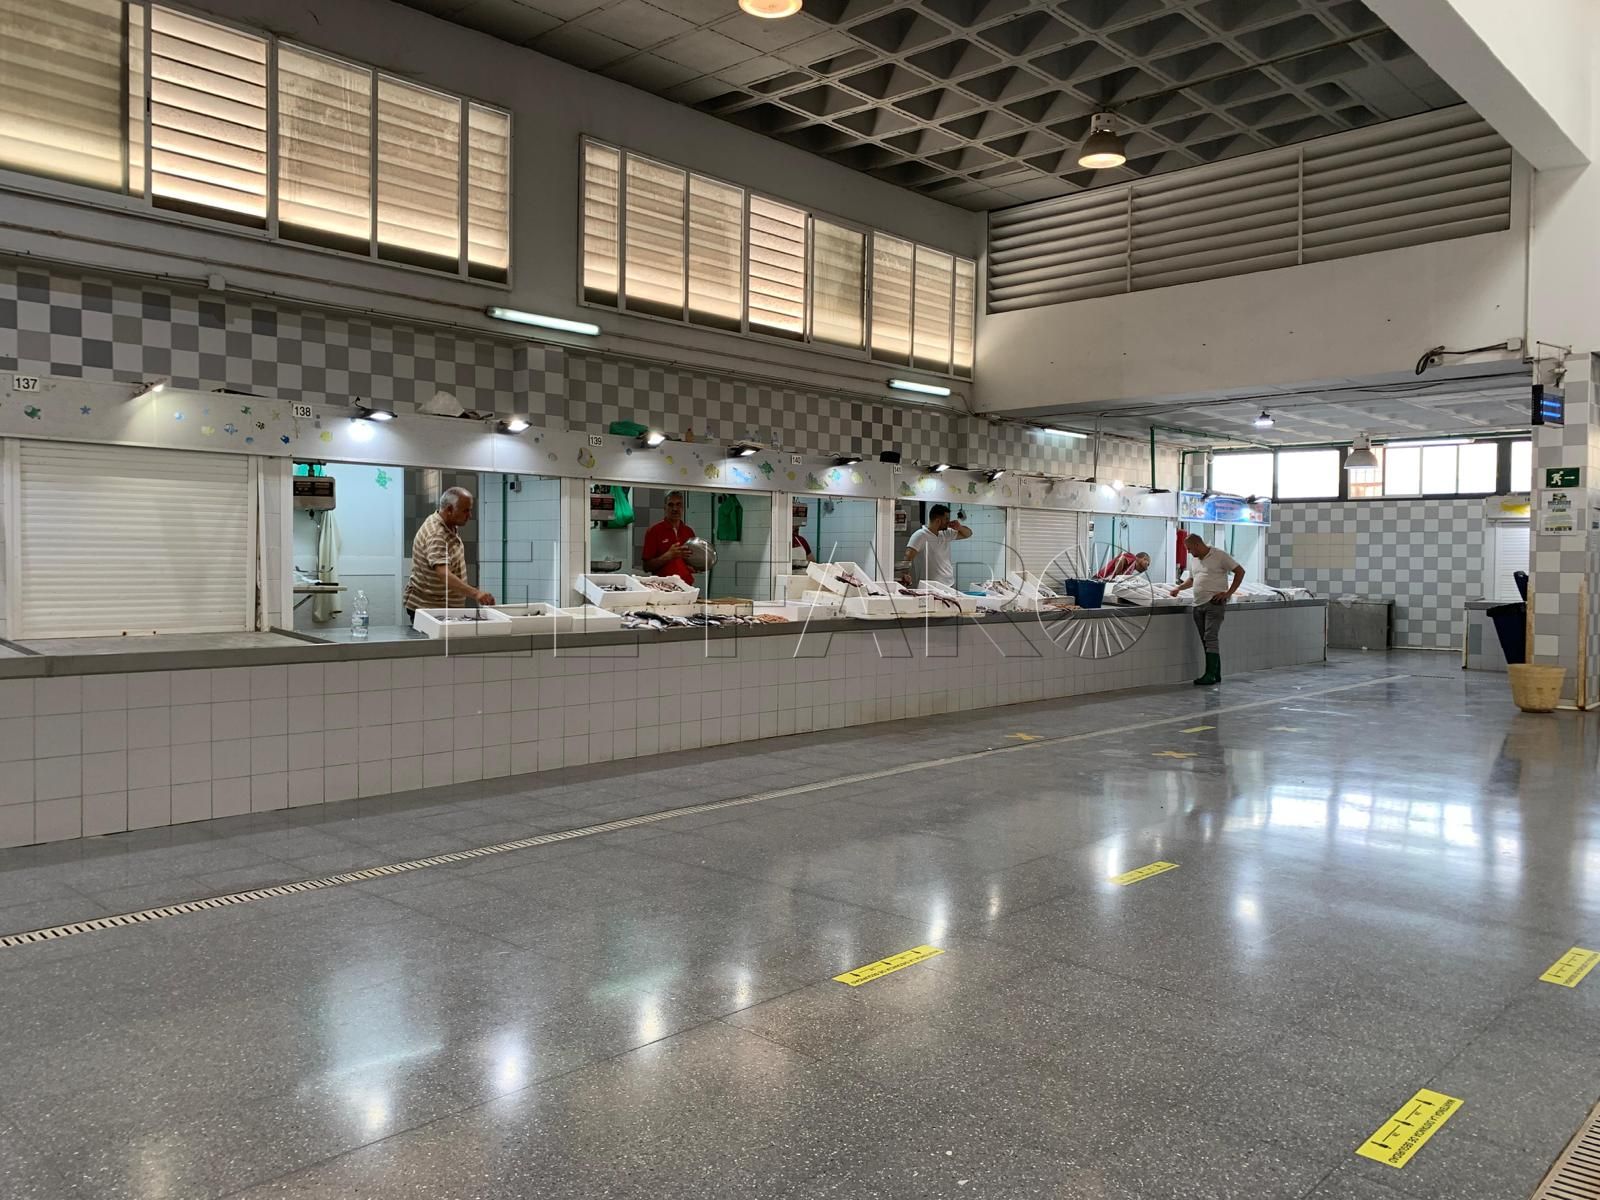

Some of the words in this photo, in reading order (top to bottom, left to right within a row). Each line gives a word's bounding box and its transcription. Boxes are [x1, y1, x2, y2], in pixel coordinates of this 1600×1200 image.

[15, 377, 38, 390] 137
[294, 406, 312, 417] 138
[590, 436, 602, 446] 139
